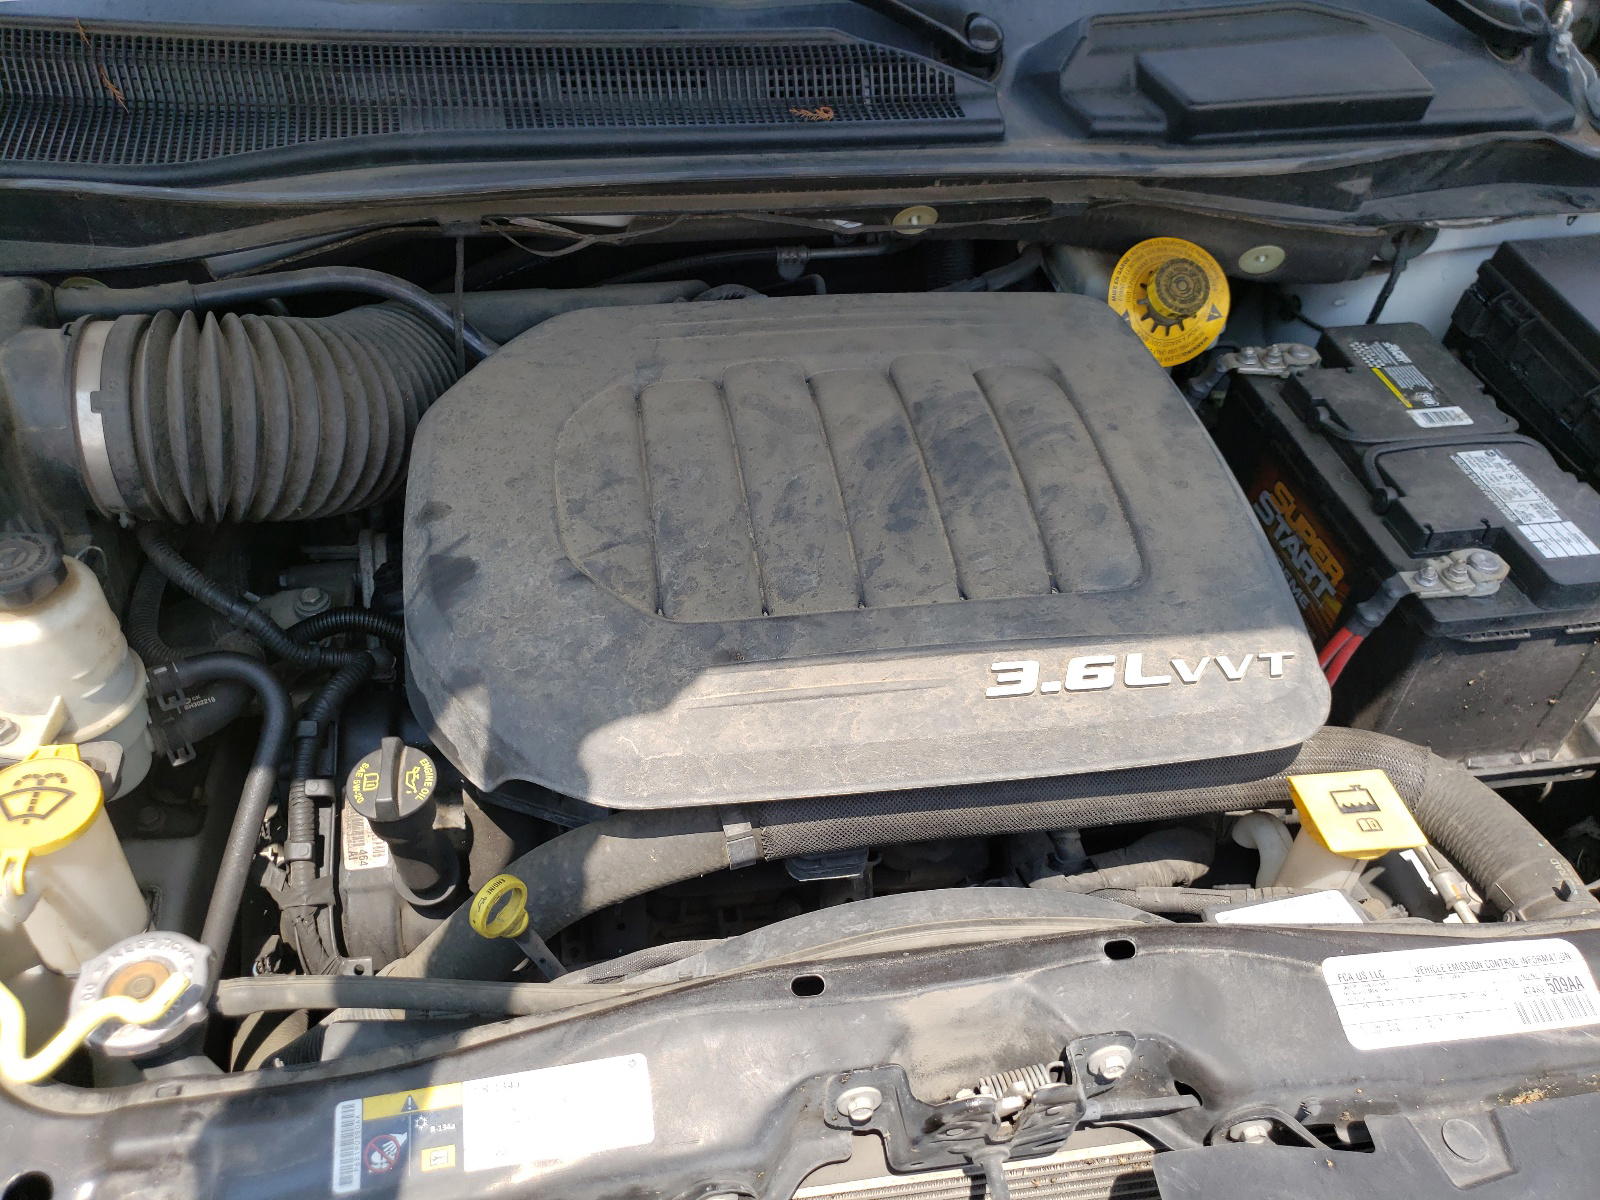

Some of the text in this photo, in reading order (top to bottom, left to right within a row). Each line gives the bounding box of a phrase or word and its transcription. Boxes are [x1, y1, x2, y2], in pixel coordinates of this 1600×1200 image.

[1253, 490, 1337, 599] START
[1269, 481, 1344, 587] SUPER
[353, 762, 370, 804] SAE 5W-20
[414, 758, 434, 801] ENGINE OIL
[487, 878, 506, 895] ENGINE
[1414, 951, 1572, 975] VEHICLE EMISSION CONTROL INFORMATON
